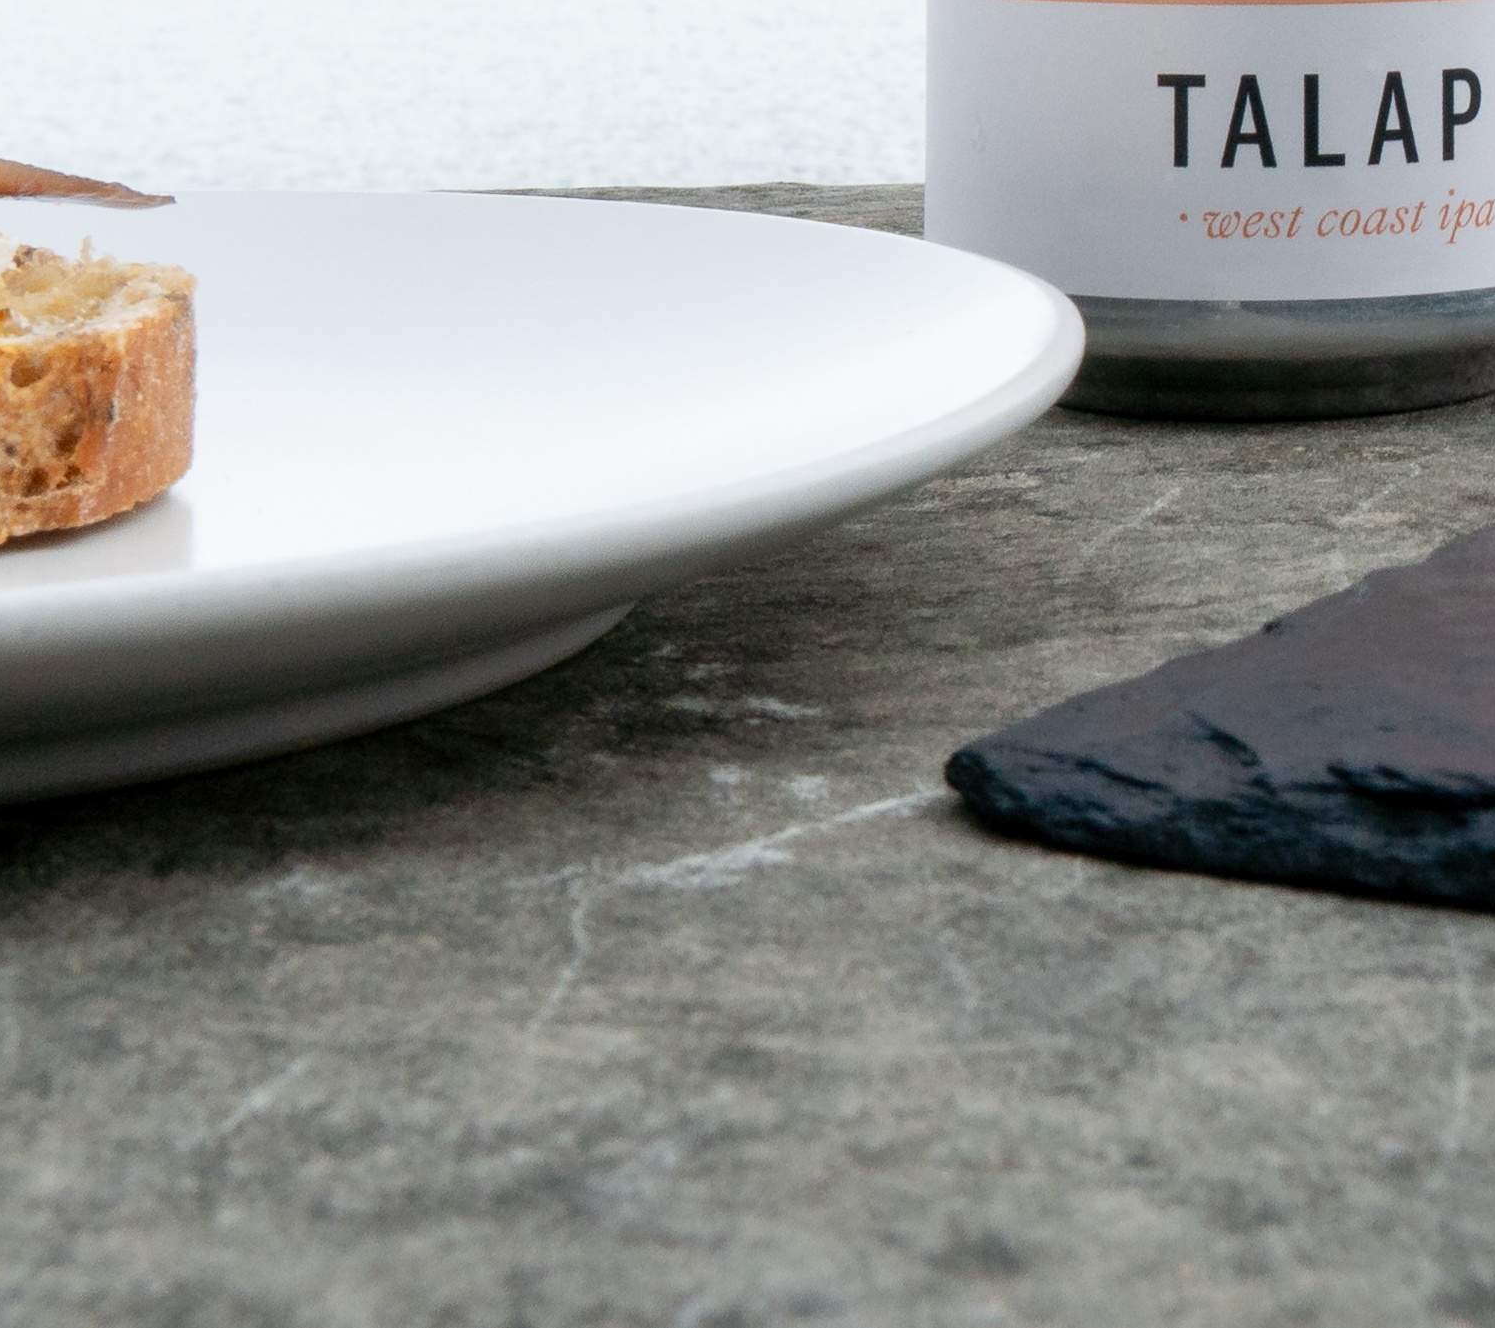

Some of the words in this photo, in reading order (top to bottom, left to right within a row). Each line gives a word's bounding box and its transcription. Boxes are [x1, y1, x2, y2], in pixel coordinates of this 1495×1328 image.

[1202, 205, 1304, 239] west
[1317, 200, 1427, 238] coast
[1438, 188, 1495, 244] ipa
